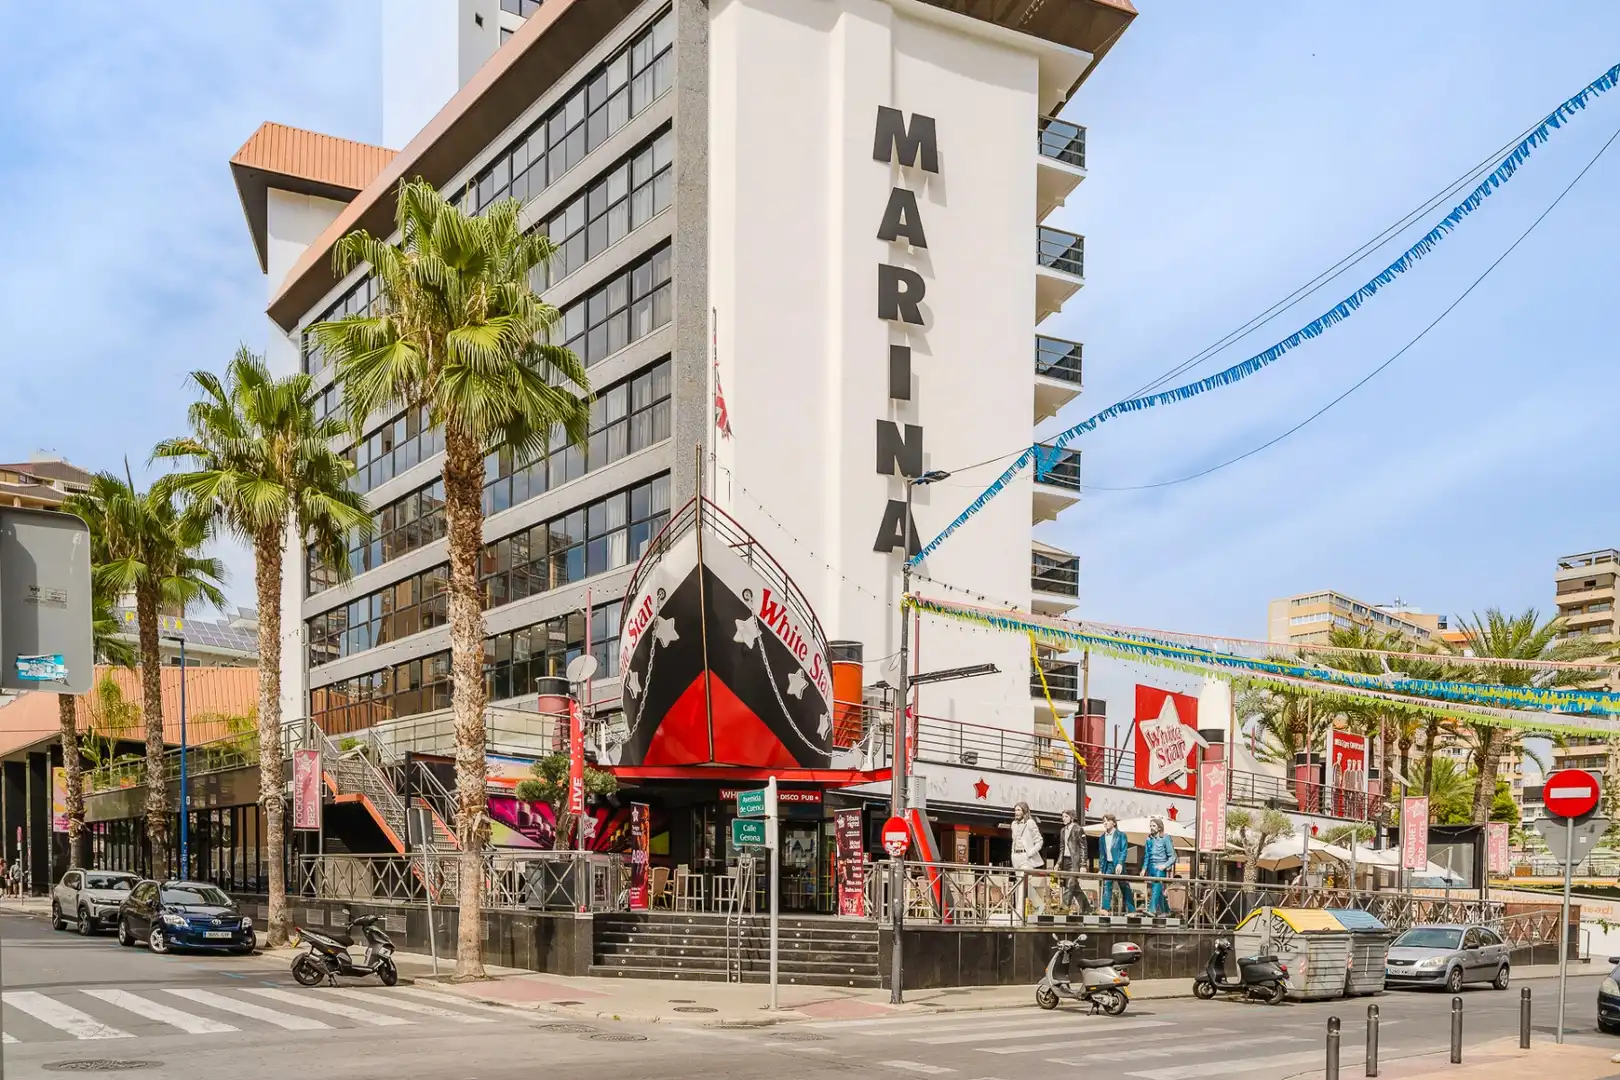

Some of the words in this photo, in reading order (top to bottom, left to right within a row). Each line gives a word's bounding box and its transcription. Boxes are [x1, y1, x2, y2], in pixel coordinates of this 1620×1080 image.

[873, 105, 939, 556] MARINA
[628, 595, 653, 648] Star
[759, 588, 808, 662] White
[1145, 724, 1182, 749] White
[1156, 739, 1186, 768] Star
[573, 777, 582, 811] LIVE
[742, 795, 761, 803] Avenida
[747, 804, 764, 812] Cuenca
[740, 834, 760, 842] Gerona
[743, 824, 757, 832] Calle
[1204, 820, 1214, 848] BEST
[631, 849, 649, 863] ABBA
[1407, 822, 1416, 865] CABARET
